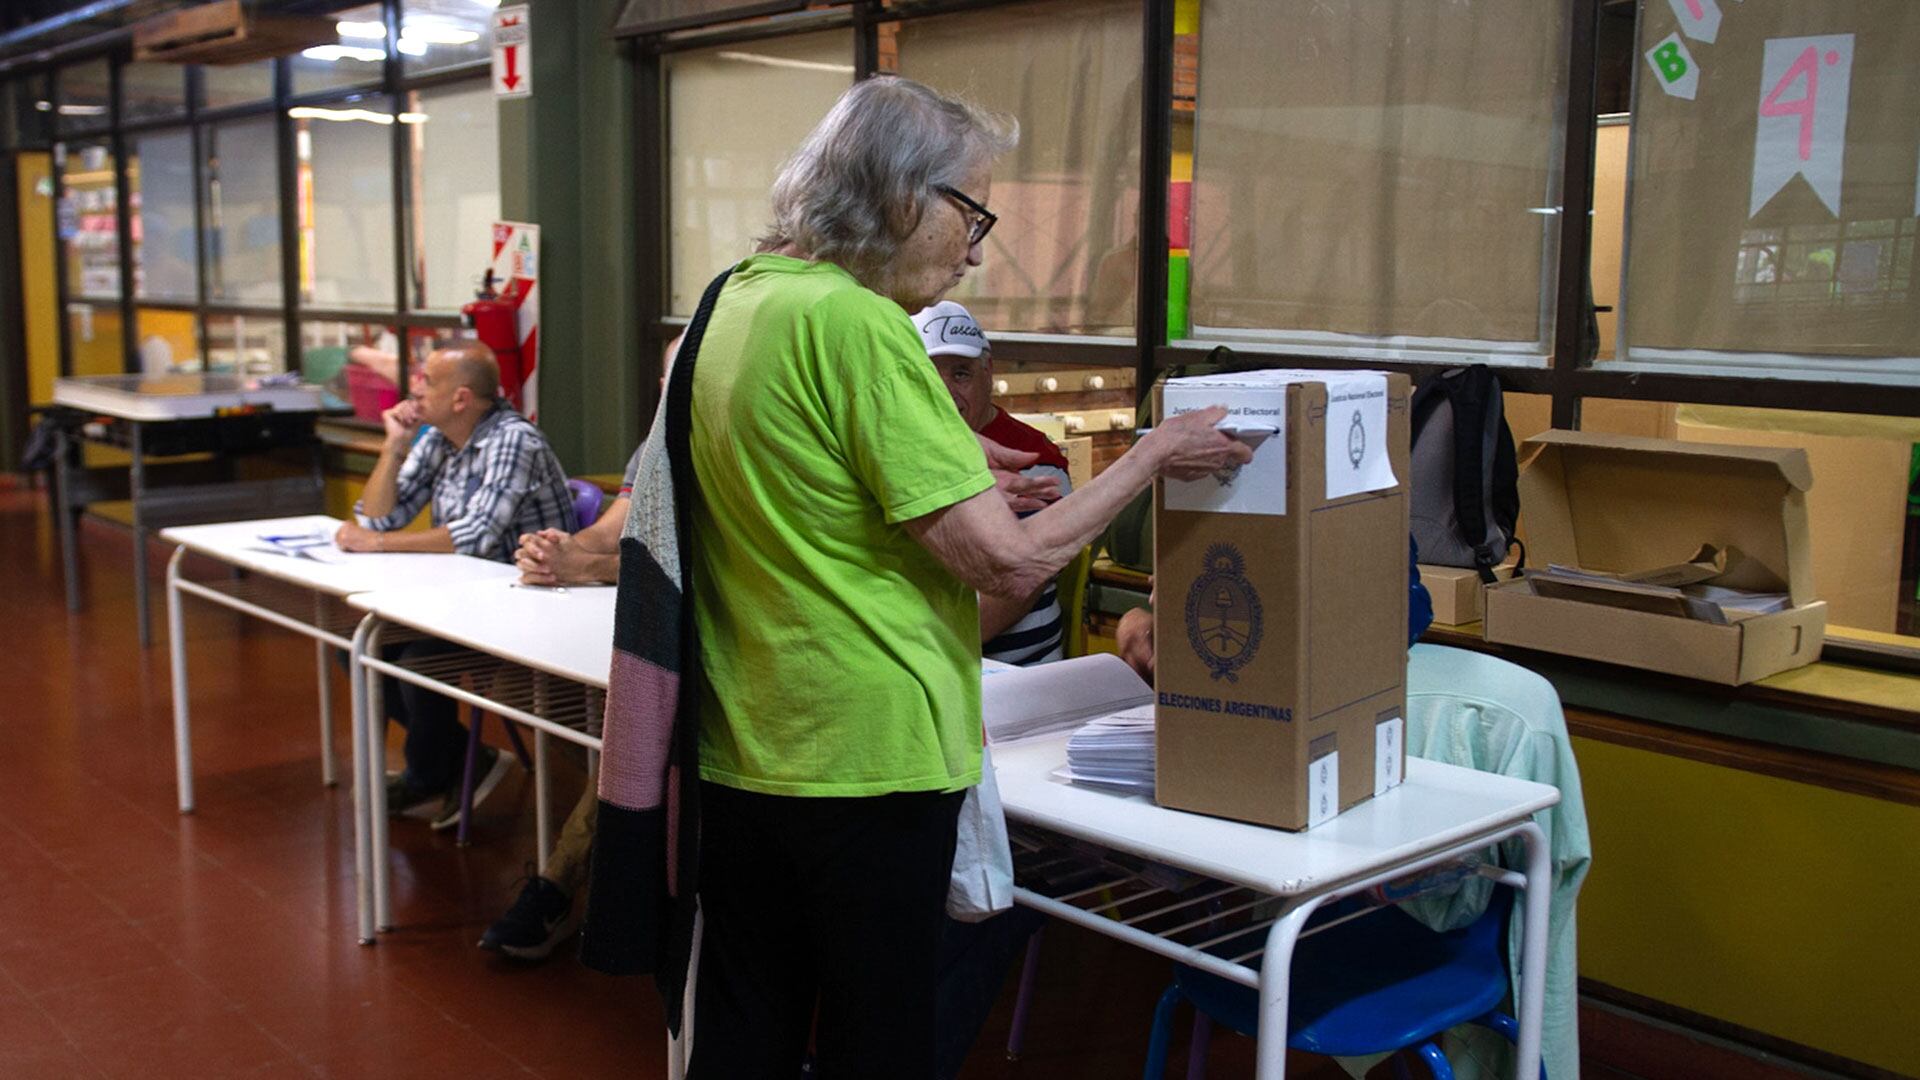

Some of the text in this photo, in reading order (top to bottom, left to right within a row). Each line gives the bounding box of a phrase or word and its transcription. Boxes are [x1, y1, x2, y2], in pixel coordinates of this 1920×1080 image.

[1653, 41, 1687, 84] B
[1243, 406, 1280, 416] Electoral
[1158, 691, 1293, 722] ELECCIONES ARGENTINAS
